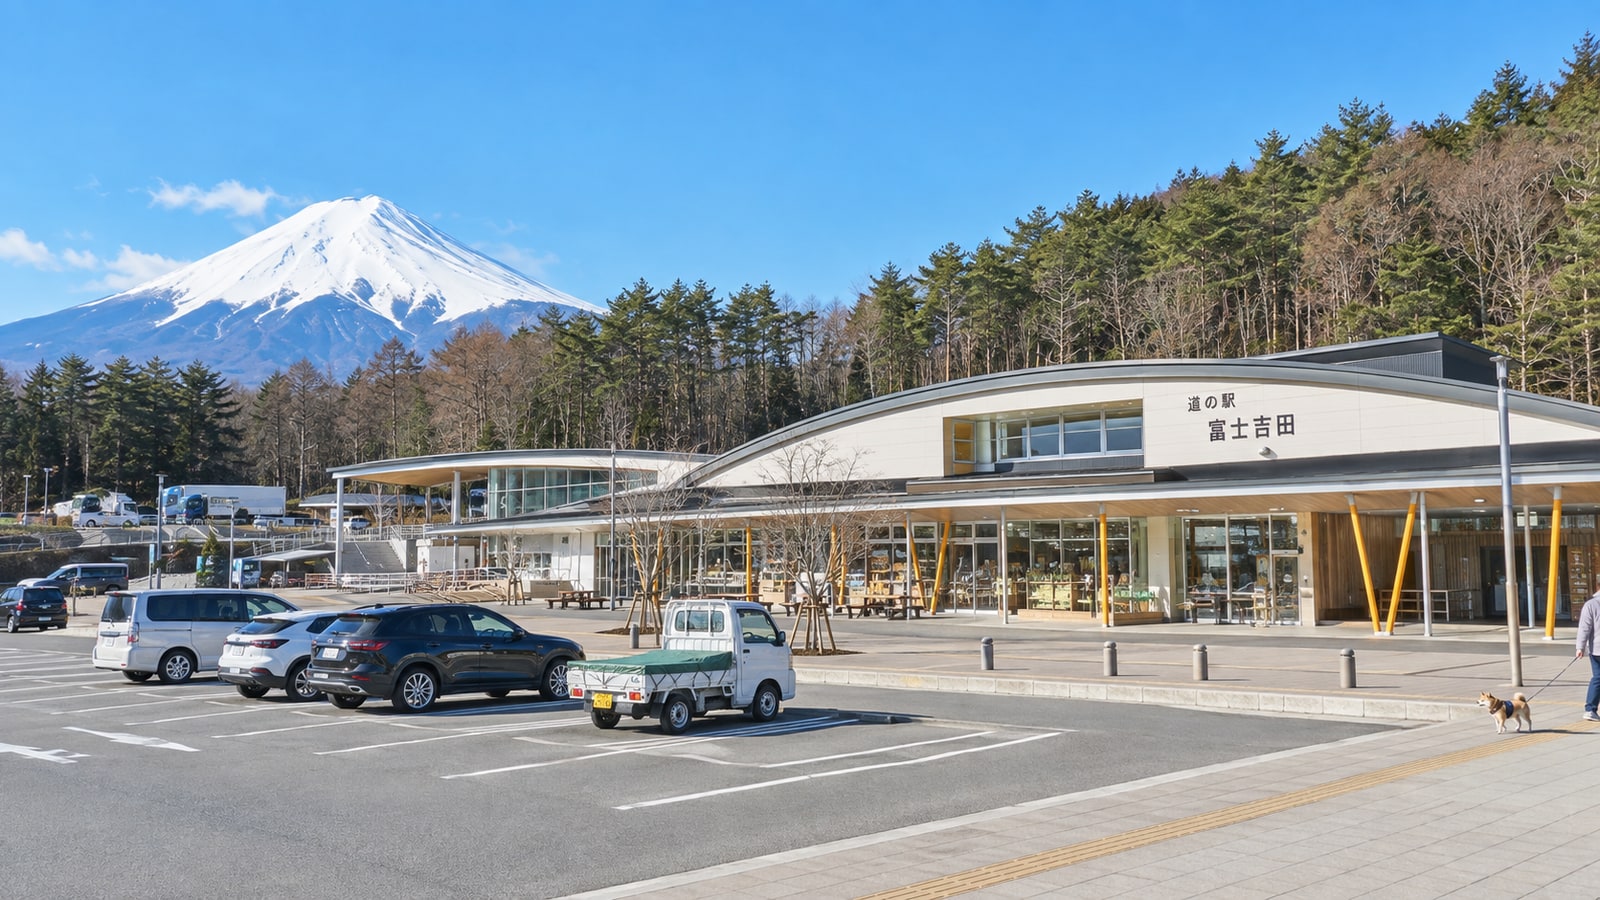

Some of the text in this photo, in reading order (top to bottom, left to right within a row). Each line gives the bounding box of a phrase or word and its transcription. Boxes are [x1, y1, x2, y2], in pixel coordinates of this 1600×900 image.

[1188, 392, 1236, 412] 道の駅
[1208, 414, 1295, 442] 富士吉田
